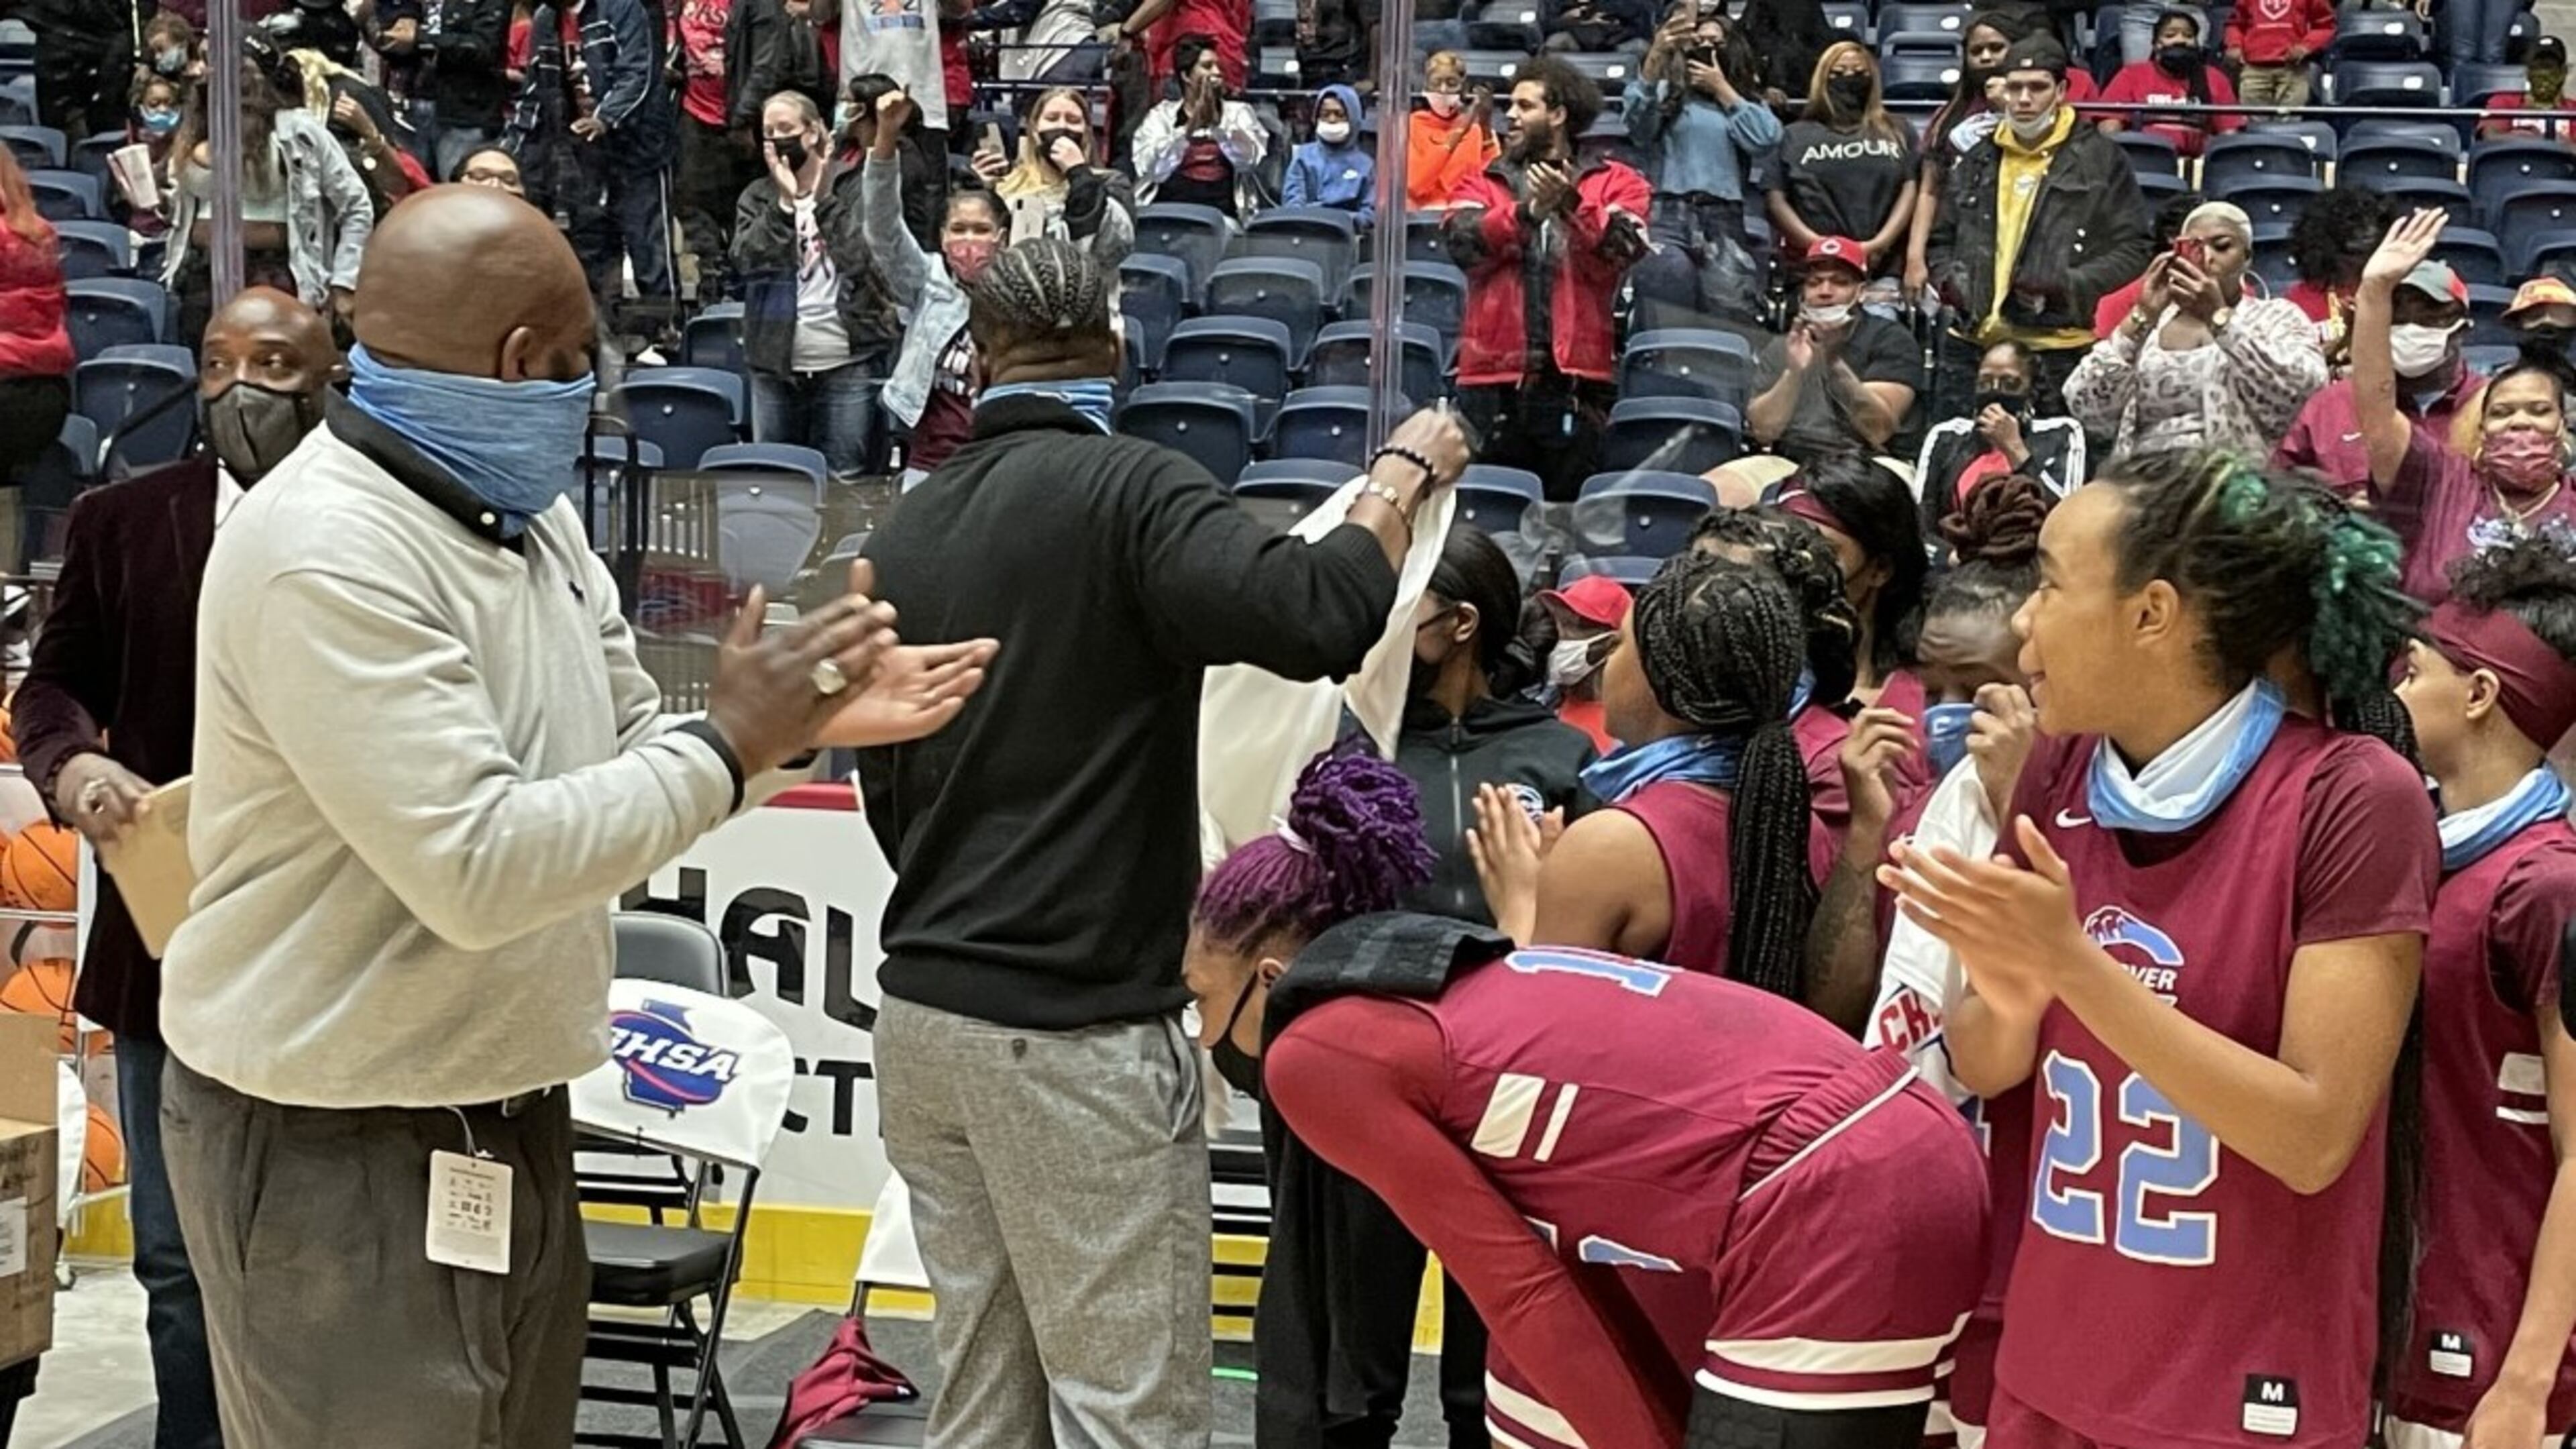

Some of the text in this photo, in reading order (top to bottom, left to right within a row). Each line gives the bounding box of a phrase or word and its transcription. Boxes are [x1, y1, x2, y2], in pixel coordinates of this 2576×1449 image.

[1801, 139, 1900, 164] AMOUR
[2120, 963, 2178, 990] VER
[1880, 994, 1942, 1054] CH
[2033, 1049, 2219, 1266] 22
[2442, 1334, 2461, 1350] M
[2261, 1381, 2284, 1401] M
